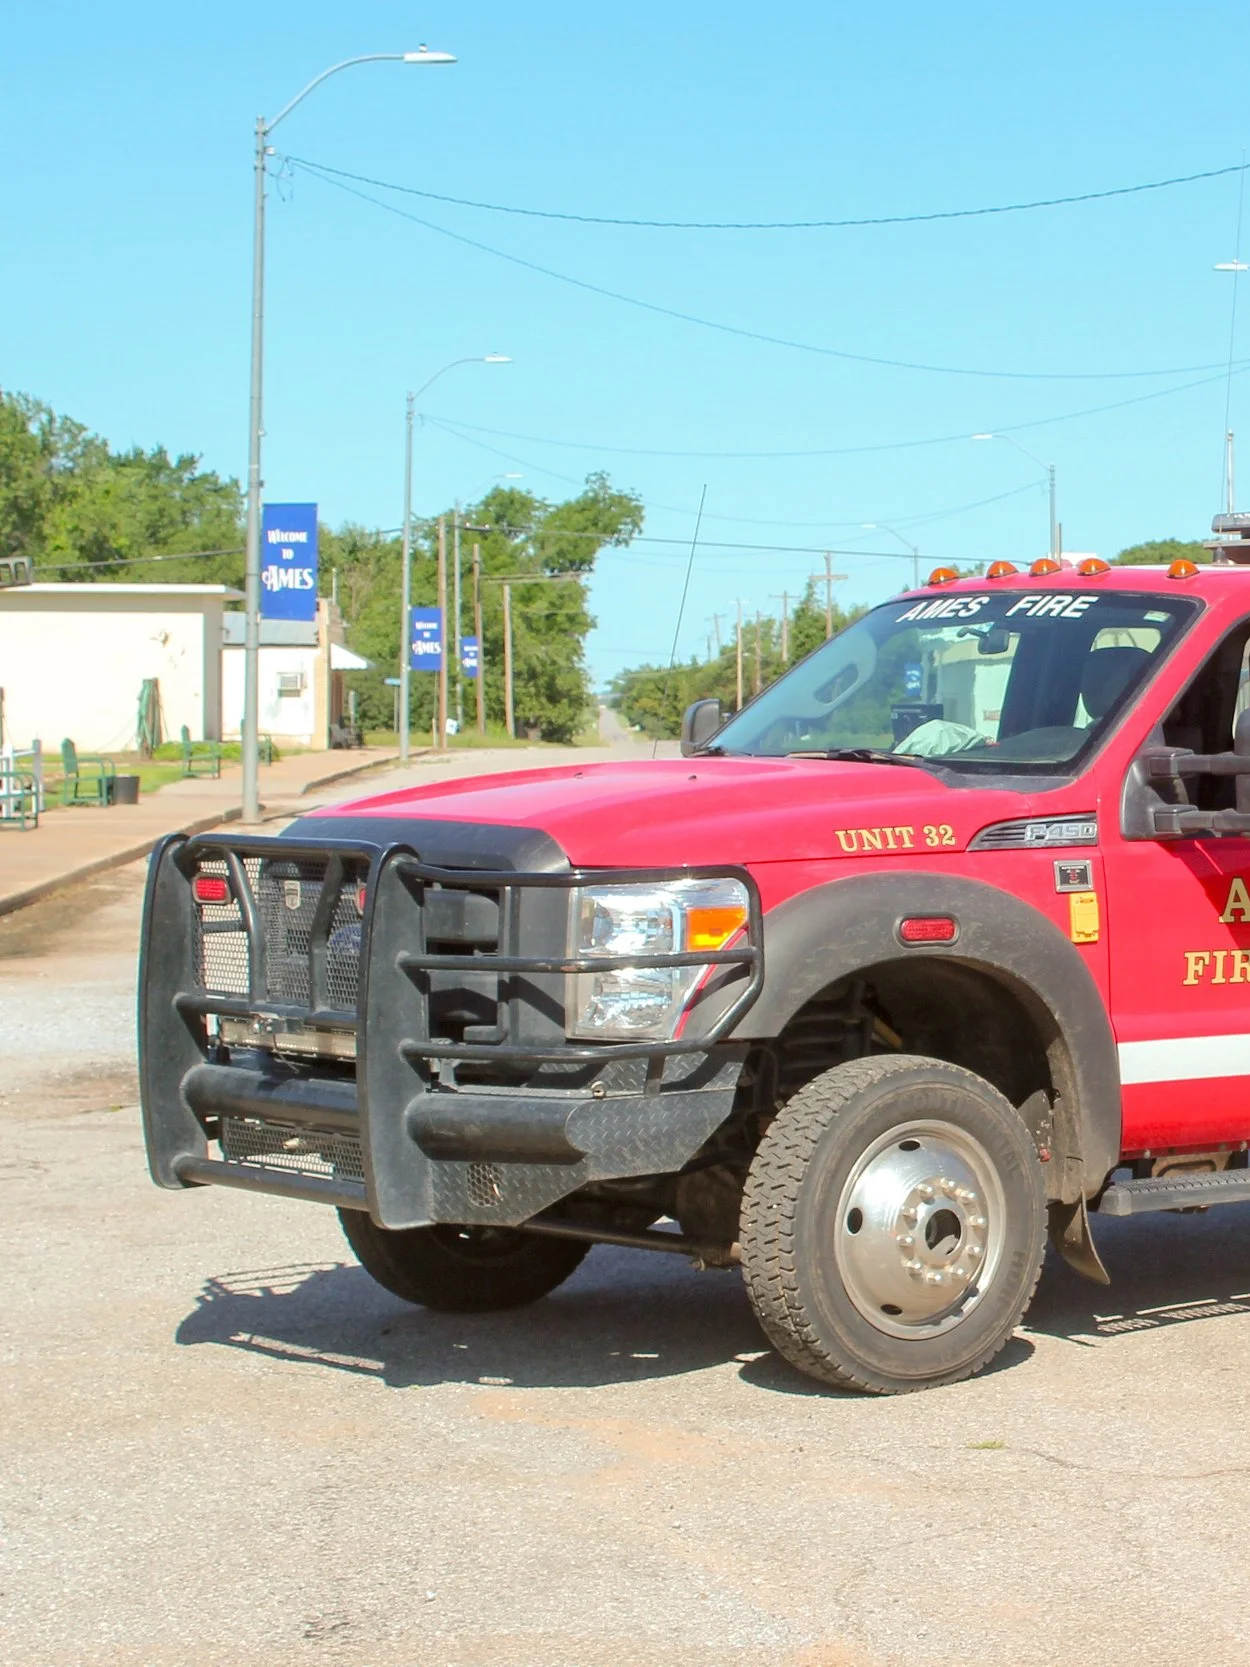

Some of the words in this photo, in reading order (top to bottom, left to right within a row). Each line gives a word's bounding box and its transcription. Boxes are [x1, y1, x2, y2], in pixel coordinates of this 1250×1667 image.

[267, 529, 308, 544] WELCOME
[281, 548, 294, 560] TO
[262, 565, 314, 592] AMES
[896, 597, 990, 623] AMES
[1005, 595, 1099, 620] FIRE
[835, 826, 914, 852] UNIT
[923, 825, 956, 848] 32
